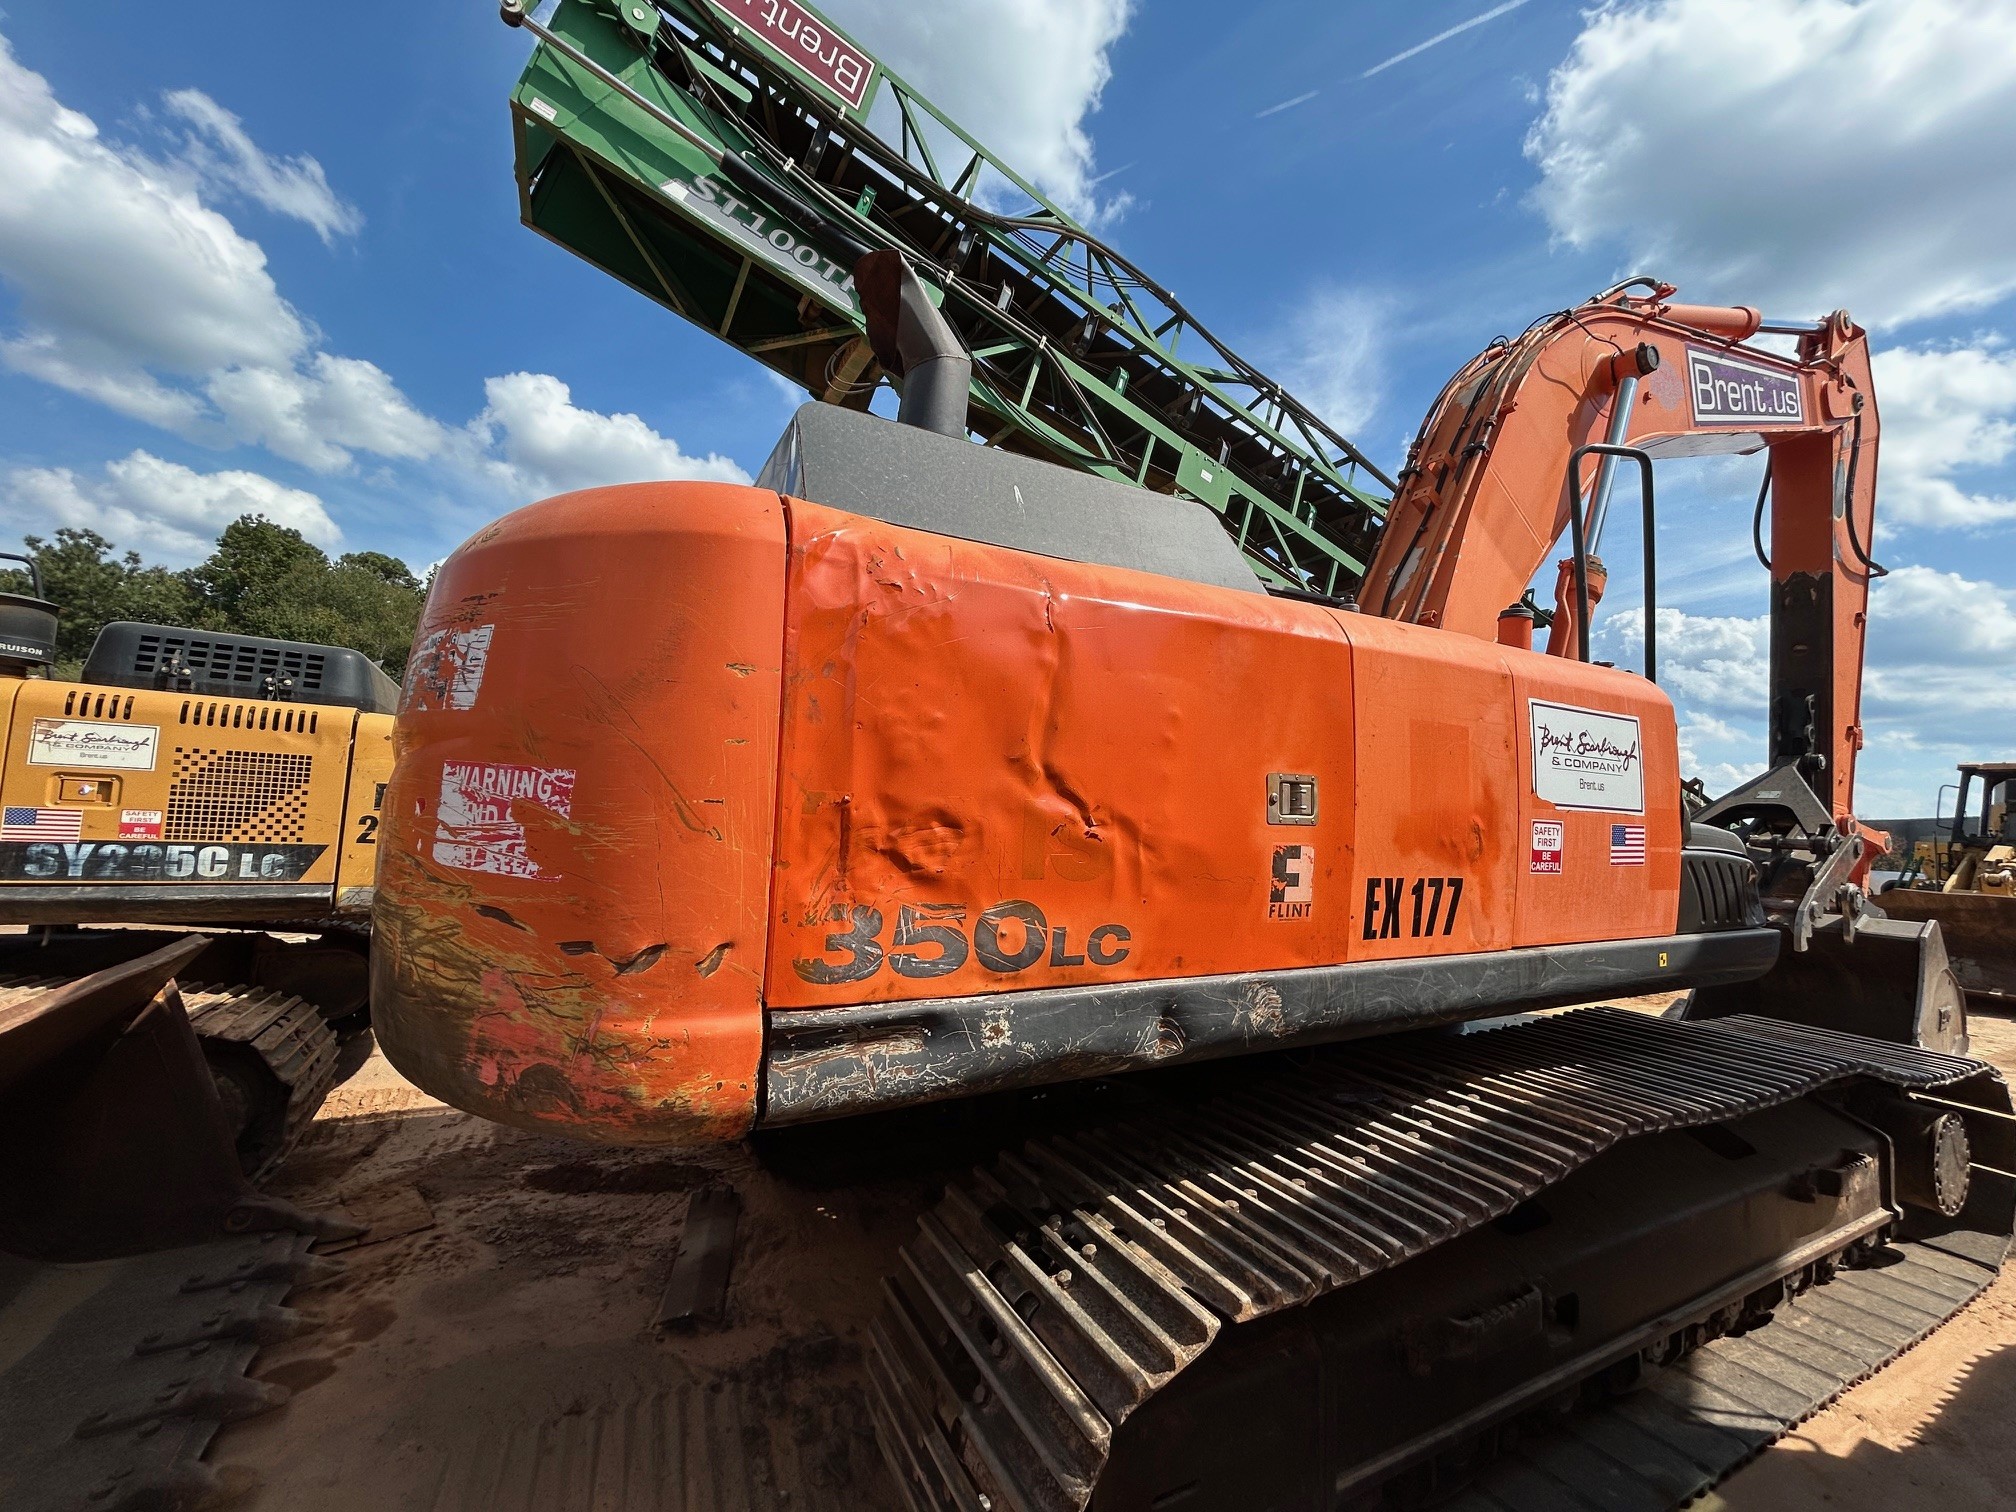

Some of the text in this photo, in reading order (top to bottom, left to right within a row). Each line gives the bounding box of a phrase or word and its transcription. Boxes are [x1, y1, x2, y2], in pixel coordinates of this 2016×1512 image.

[744, 0, 864, 95] Brent
[1693, 362, 1798, 415] Brent.us
[43, 731, 78, 742] Brent
[66, 742, 131, 752] COMPANY
[1537, 723, 1638, 772] Brent Scarbrough
[1551, 756, 1623, 773] & COMPANY
[455, 765, 552, 800] WARNING
[1579, 777, 1606, 792] Brent.us
[1534, 826, 1560, 836] SAFETY
[1537, 838, 1557, 847] FIRST
[1541, 851, 1552, 861] BE
[1531, 861, 1561, 871] CAREFUL
[1269, 903, 1312, 918] FLINT
[1362, 877, 1464, 940] EX 177
